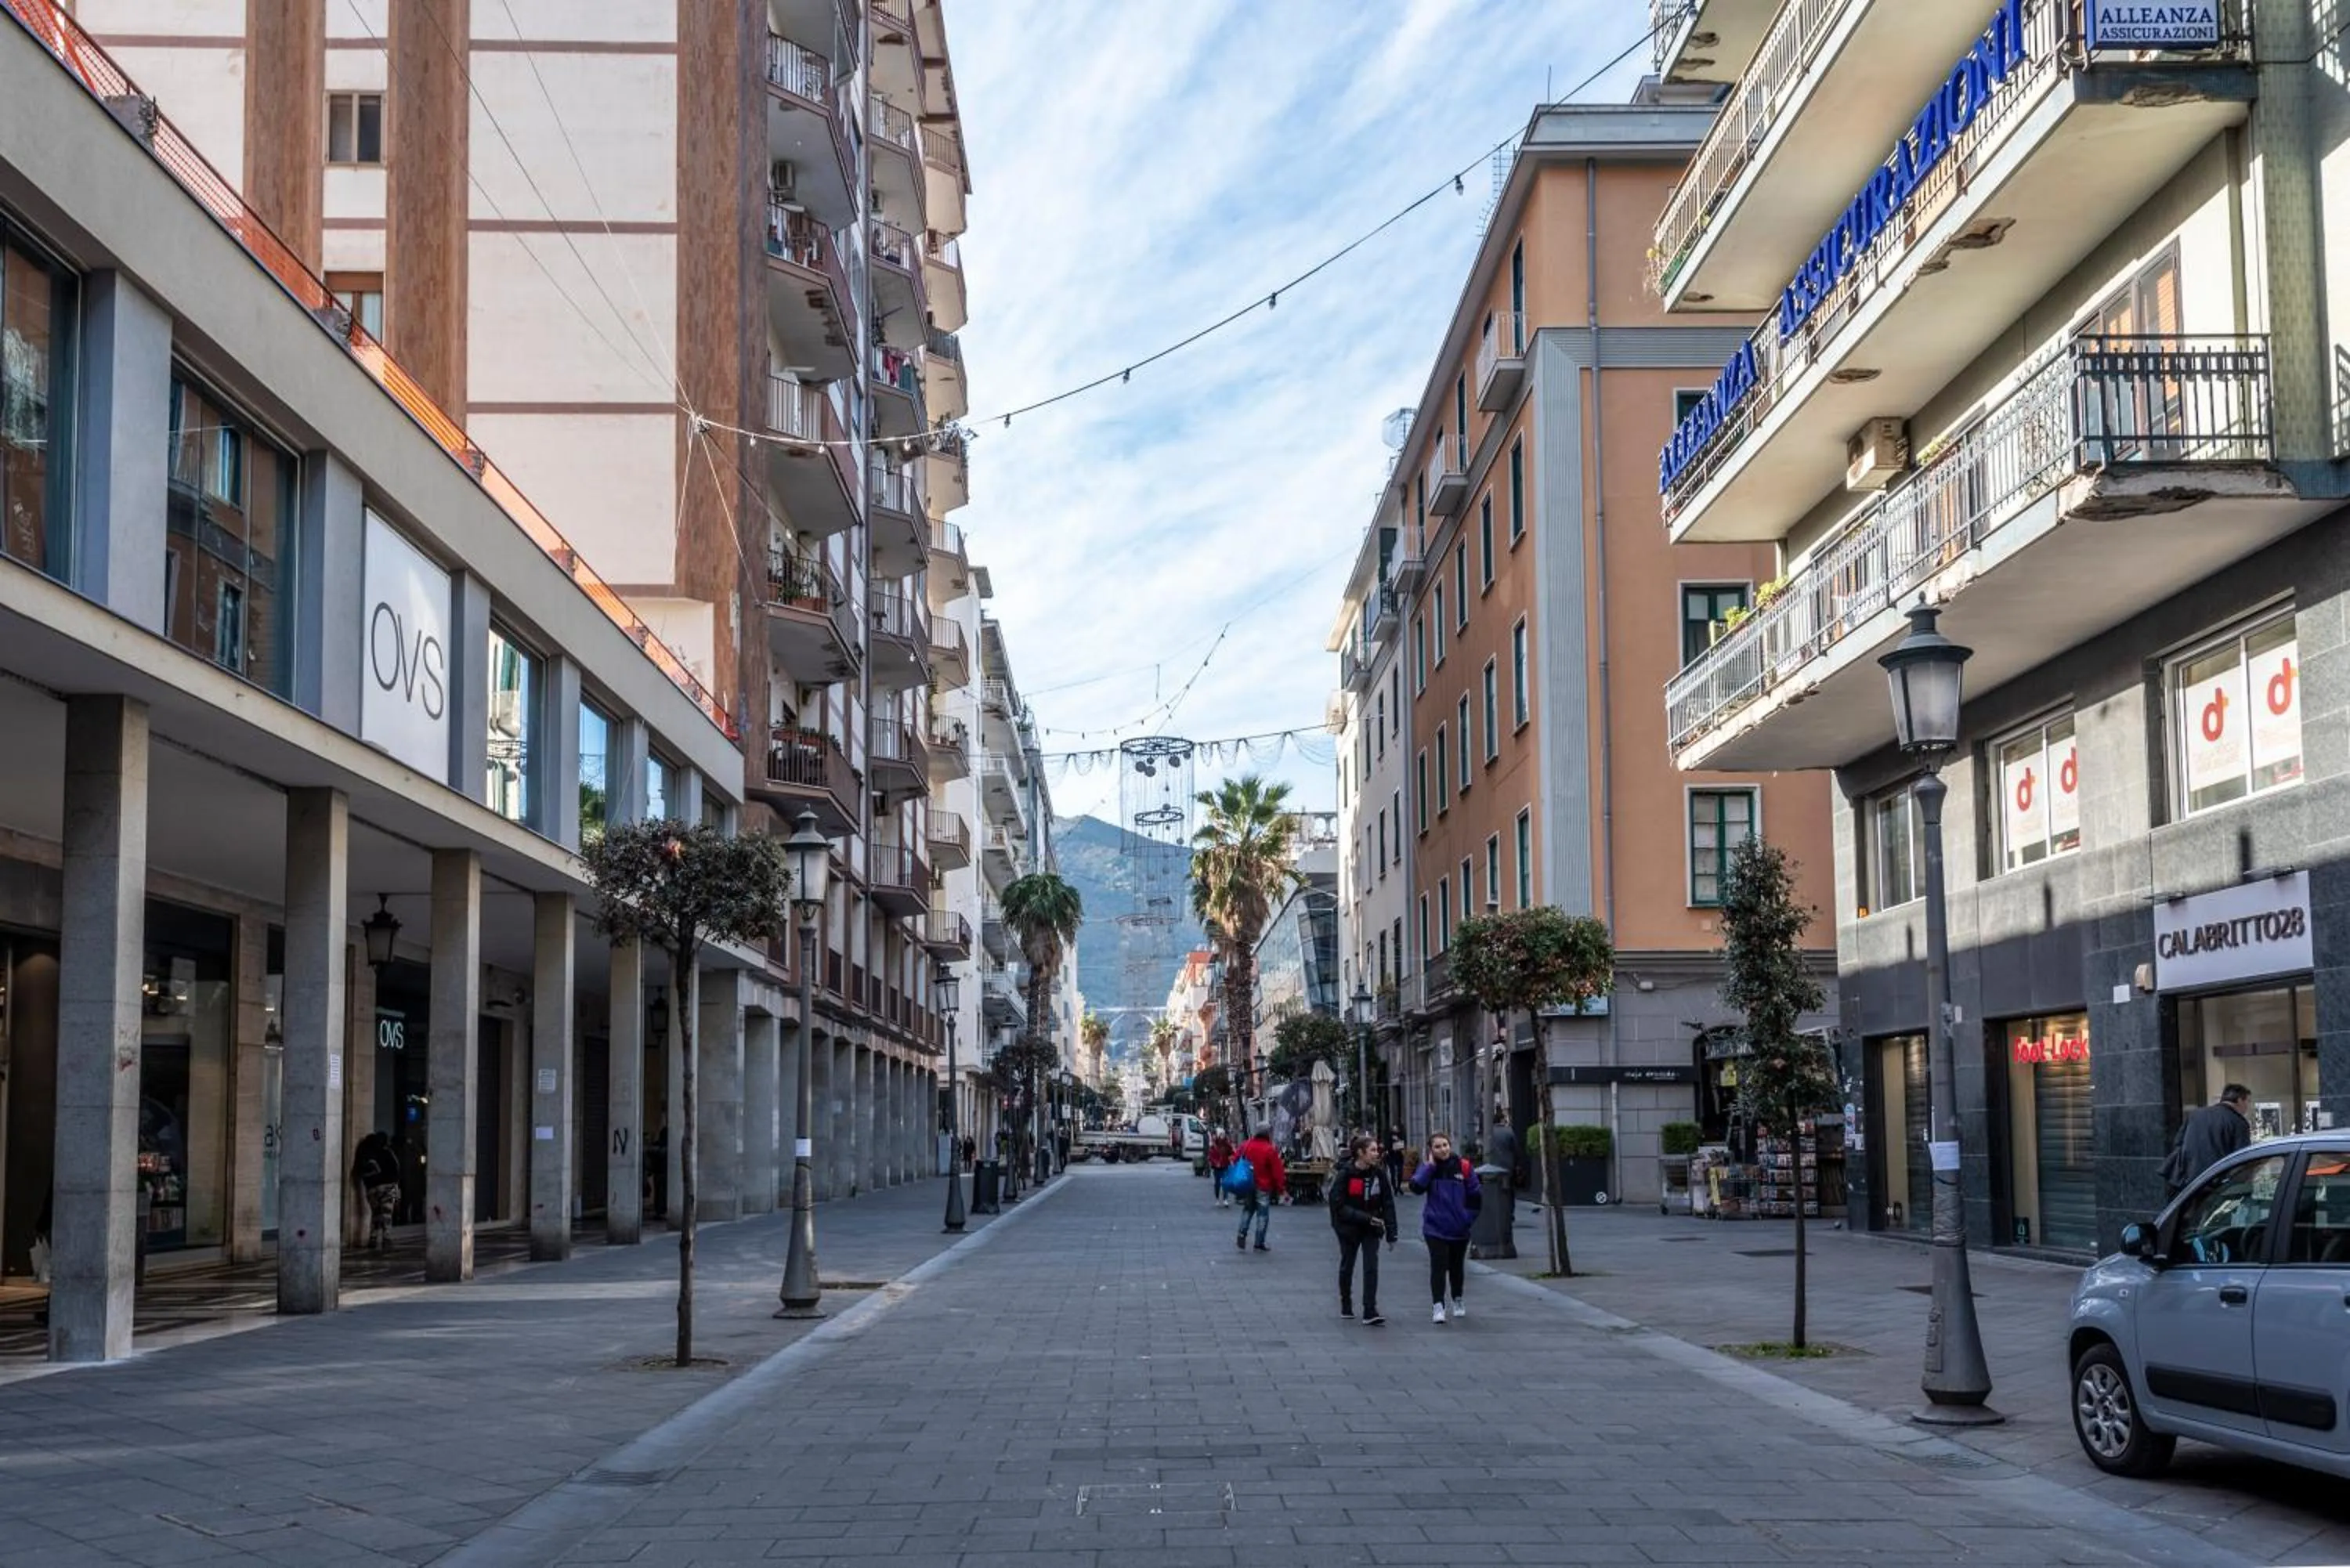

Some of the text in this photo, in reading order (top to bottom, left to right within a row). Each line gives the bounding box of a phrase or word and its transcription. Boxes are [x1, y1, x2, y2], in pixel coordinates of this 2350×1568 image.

[2100, 7, 2213, 23] ALLEANZA
[2100, 27, 2214, 39] ASSICURAZIONI
[1779, 0, 2027, 348] ASSICURAZIONI
[371, 602, 444, 721] OVS
[2158, 906, 2305, 959] CALABRITTO28
[379, 1020, 404, 1050] OVS
[2013, 1035, 2047, 1064] Foot
